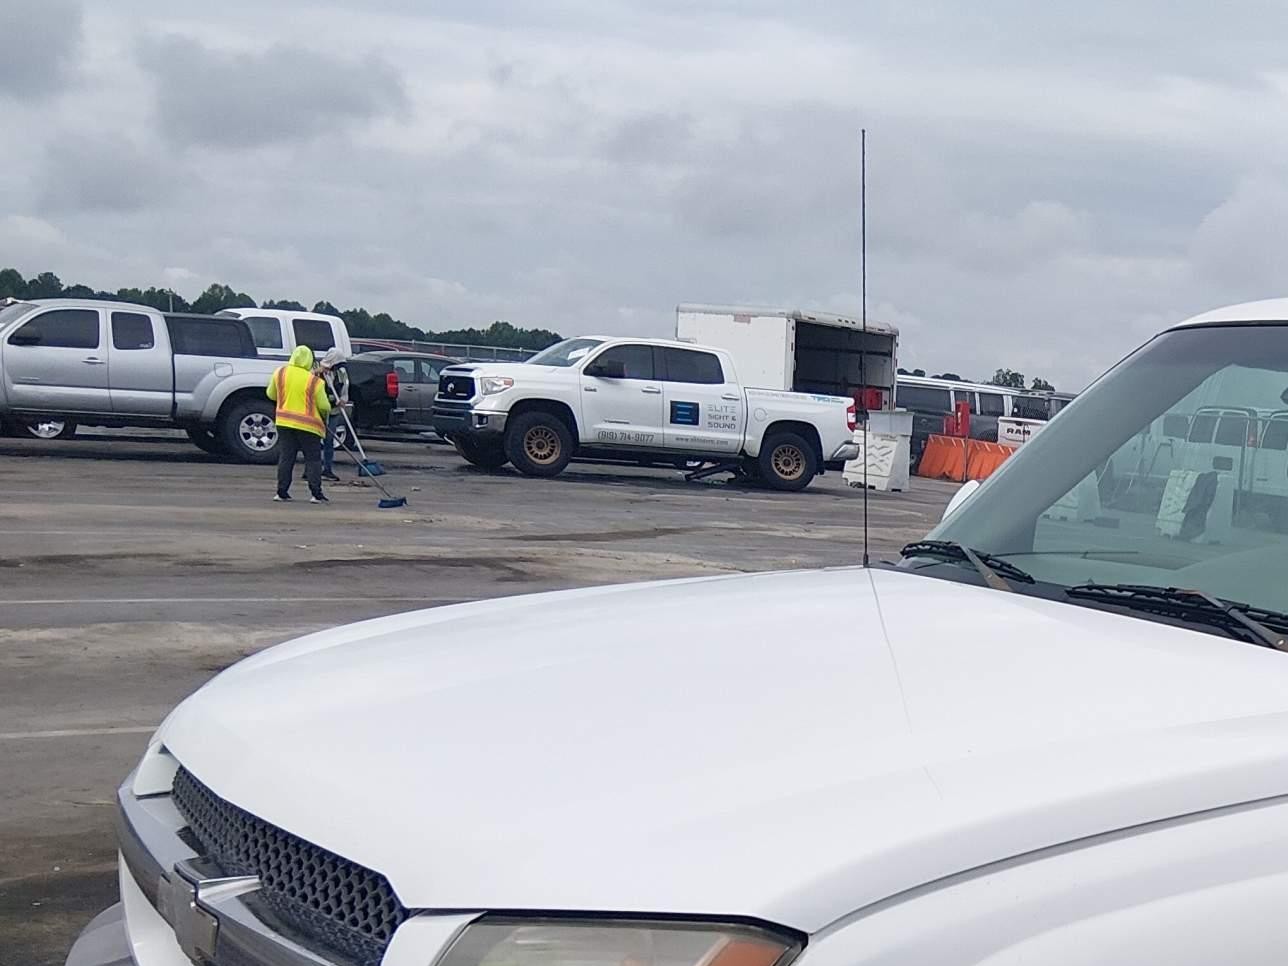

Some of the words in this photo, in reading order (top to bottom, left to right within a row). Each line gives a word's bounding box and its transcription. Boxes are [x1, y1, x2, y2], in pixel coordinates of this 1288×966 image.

[707, 404, 736, 413] ELITE
[707, 421, 736, 430] SOUND
[1007, 428, 1031, 436] RAM
